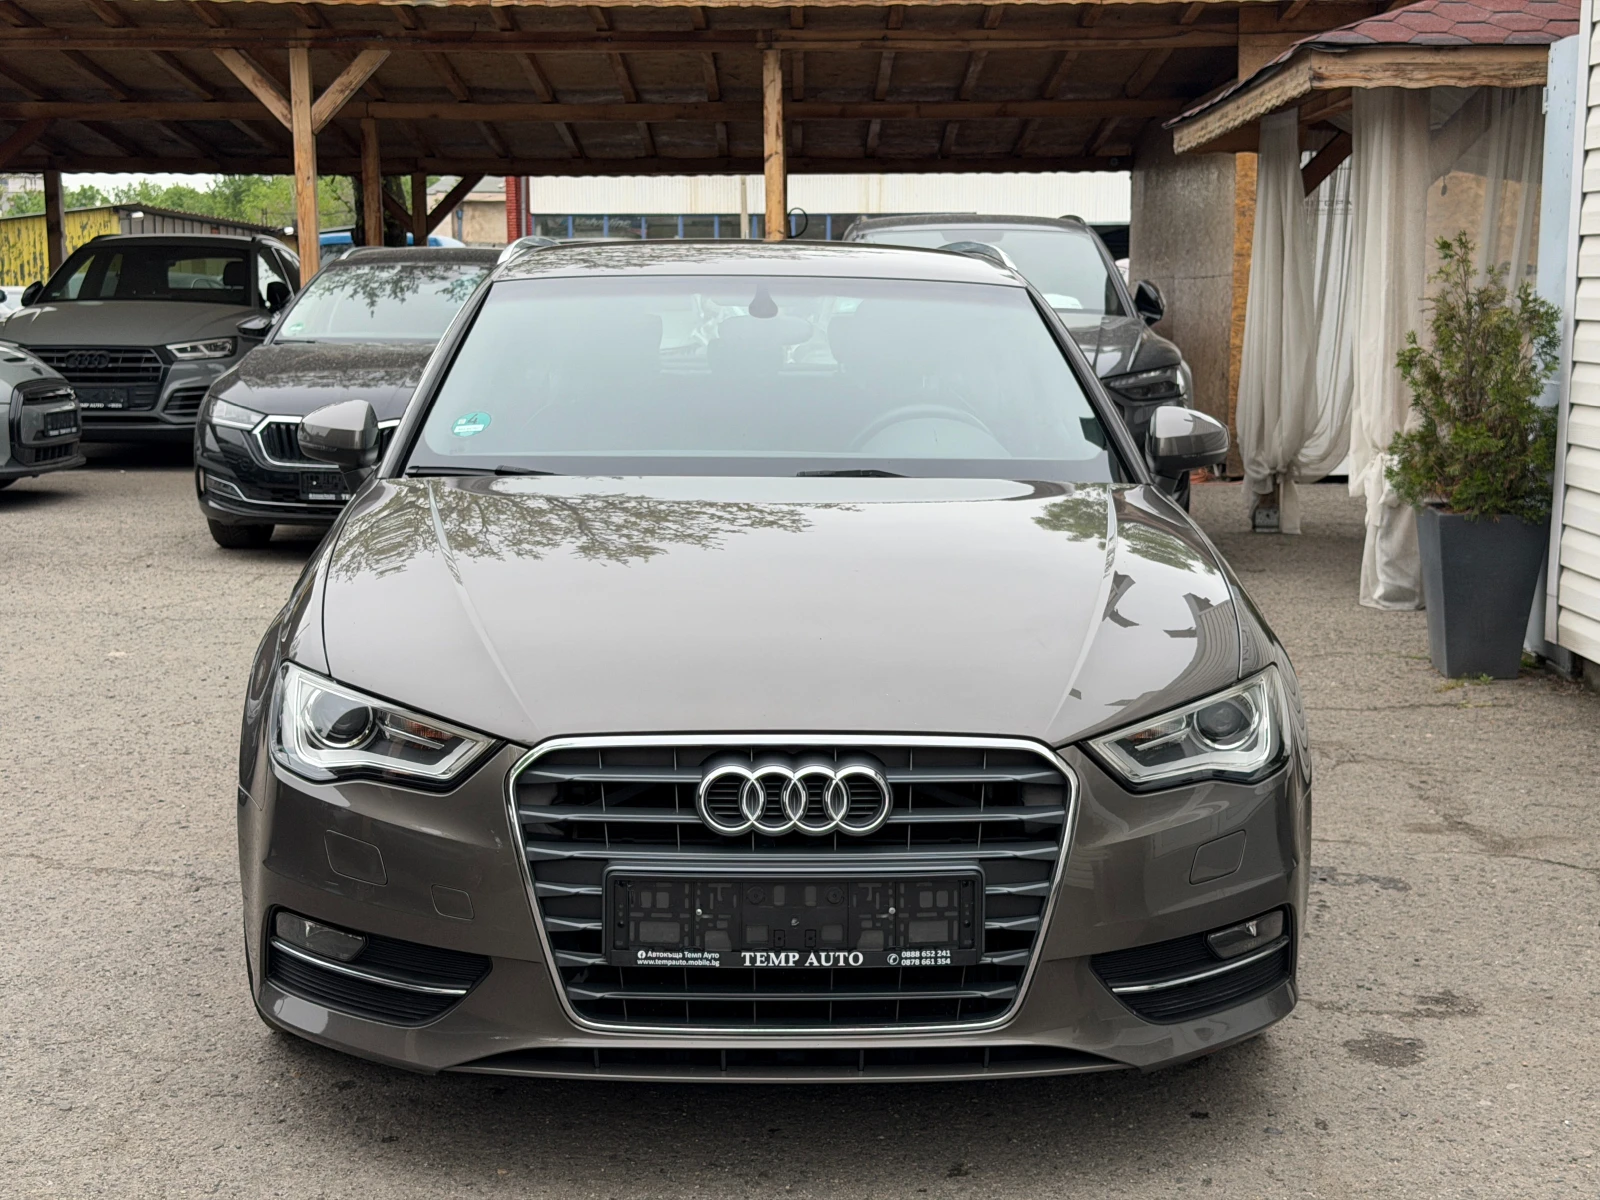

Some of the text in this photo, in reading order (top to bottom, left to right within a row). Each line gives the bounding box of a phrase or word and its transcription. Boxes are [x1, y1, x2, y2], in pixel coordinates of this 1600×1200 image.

[647, 951, 682, 959] Автокъща
[684, 951, 702, 959] Темп
[741, 952, 864, 966] TEMP AUTO
[637, 959, 720, 967] www.tempauto.mobile.bg
